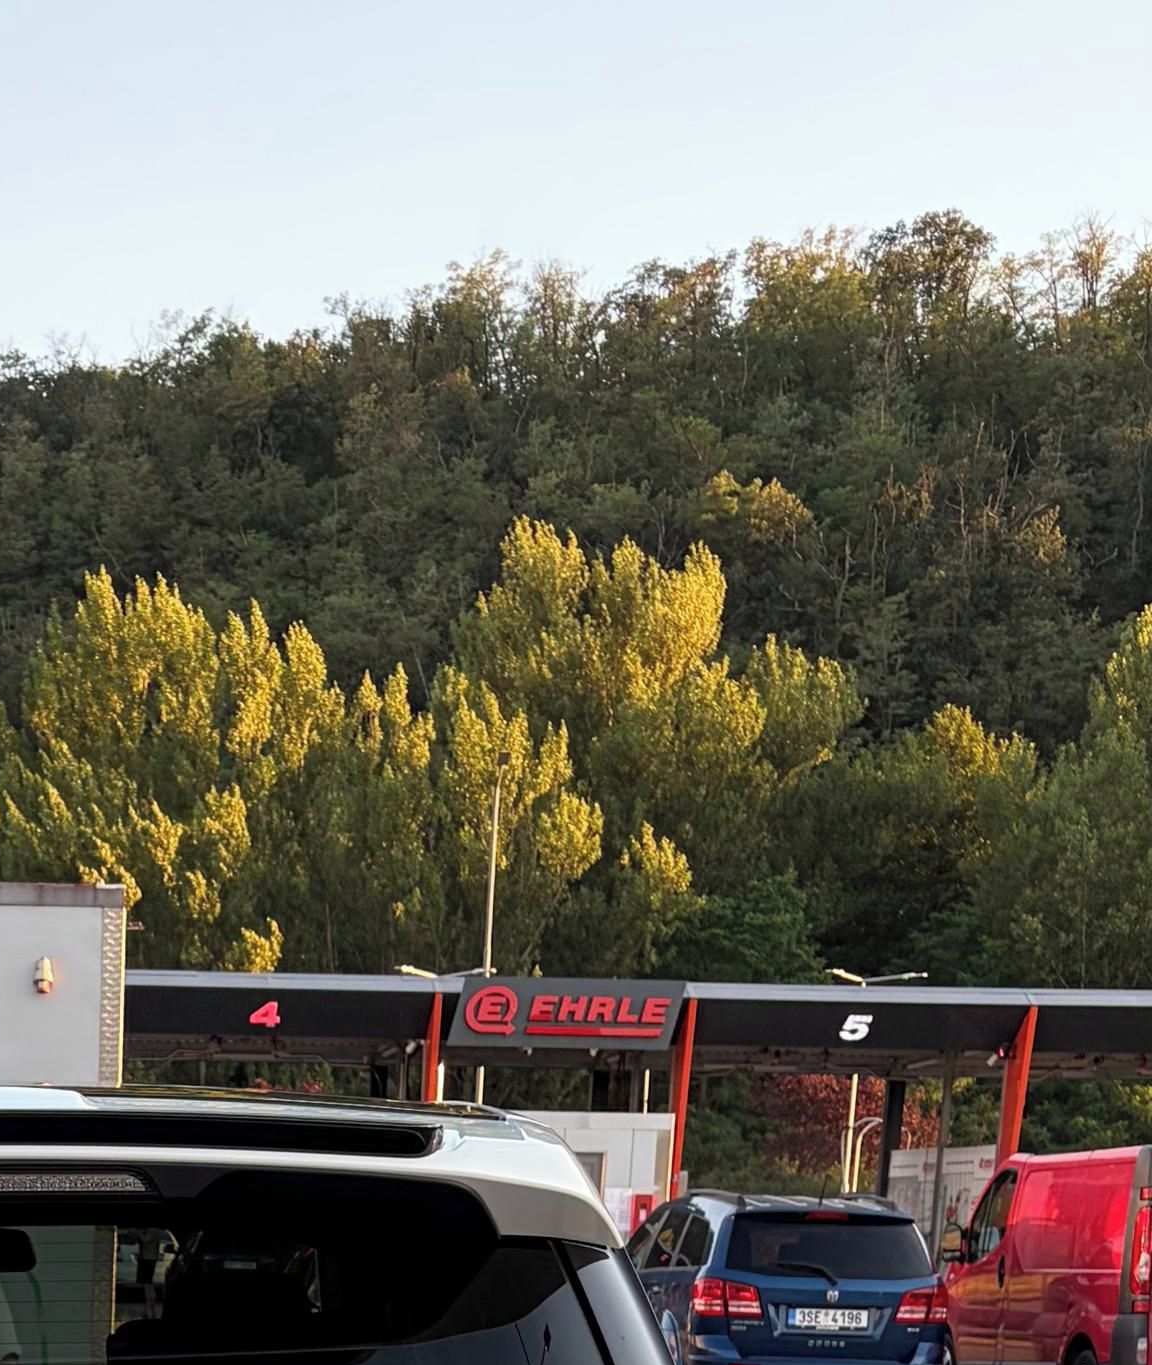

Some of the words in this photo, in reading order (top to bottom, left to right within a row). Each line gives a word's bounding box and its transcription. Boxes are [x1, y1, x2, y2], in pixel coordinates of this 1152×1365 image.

[249, 1001, 281, 1028] 4
[528, 994, 672, 1025] EHRLE
[839, 1014, 873, 1041] 5
[798, 1309, 822, 1324] 3SE
[831, 1311, 863, 1325] 4196
